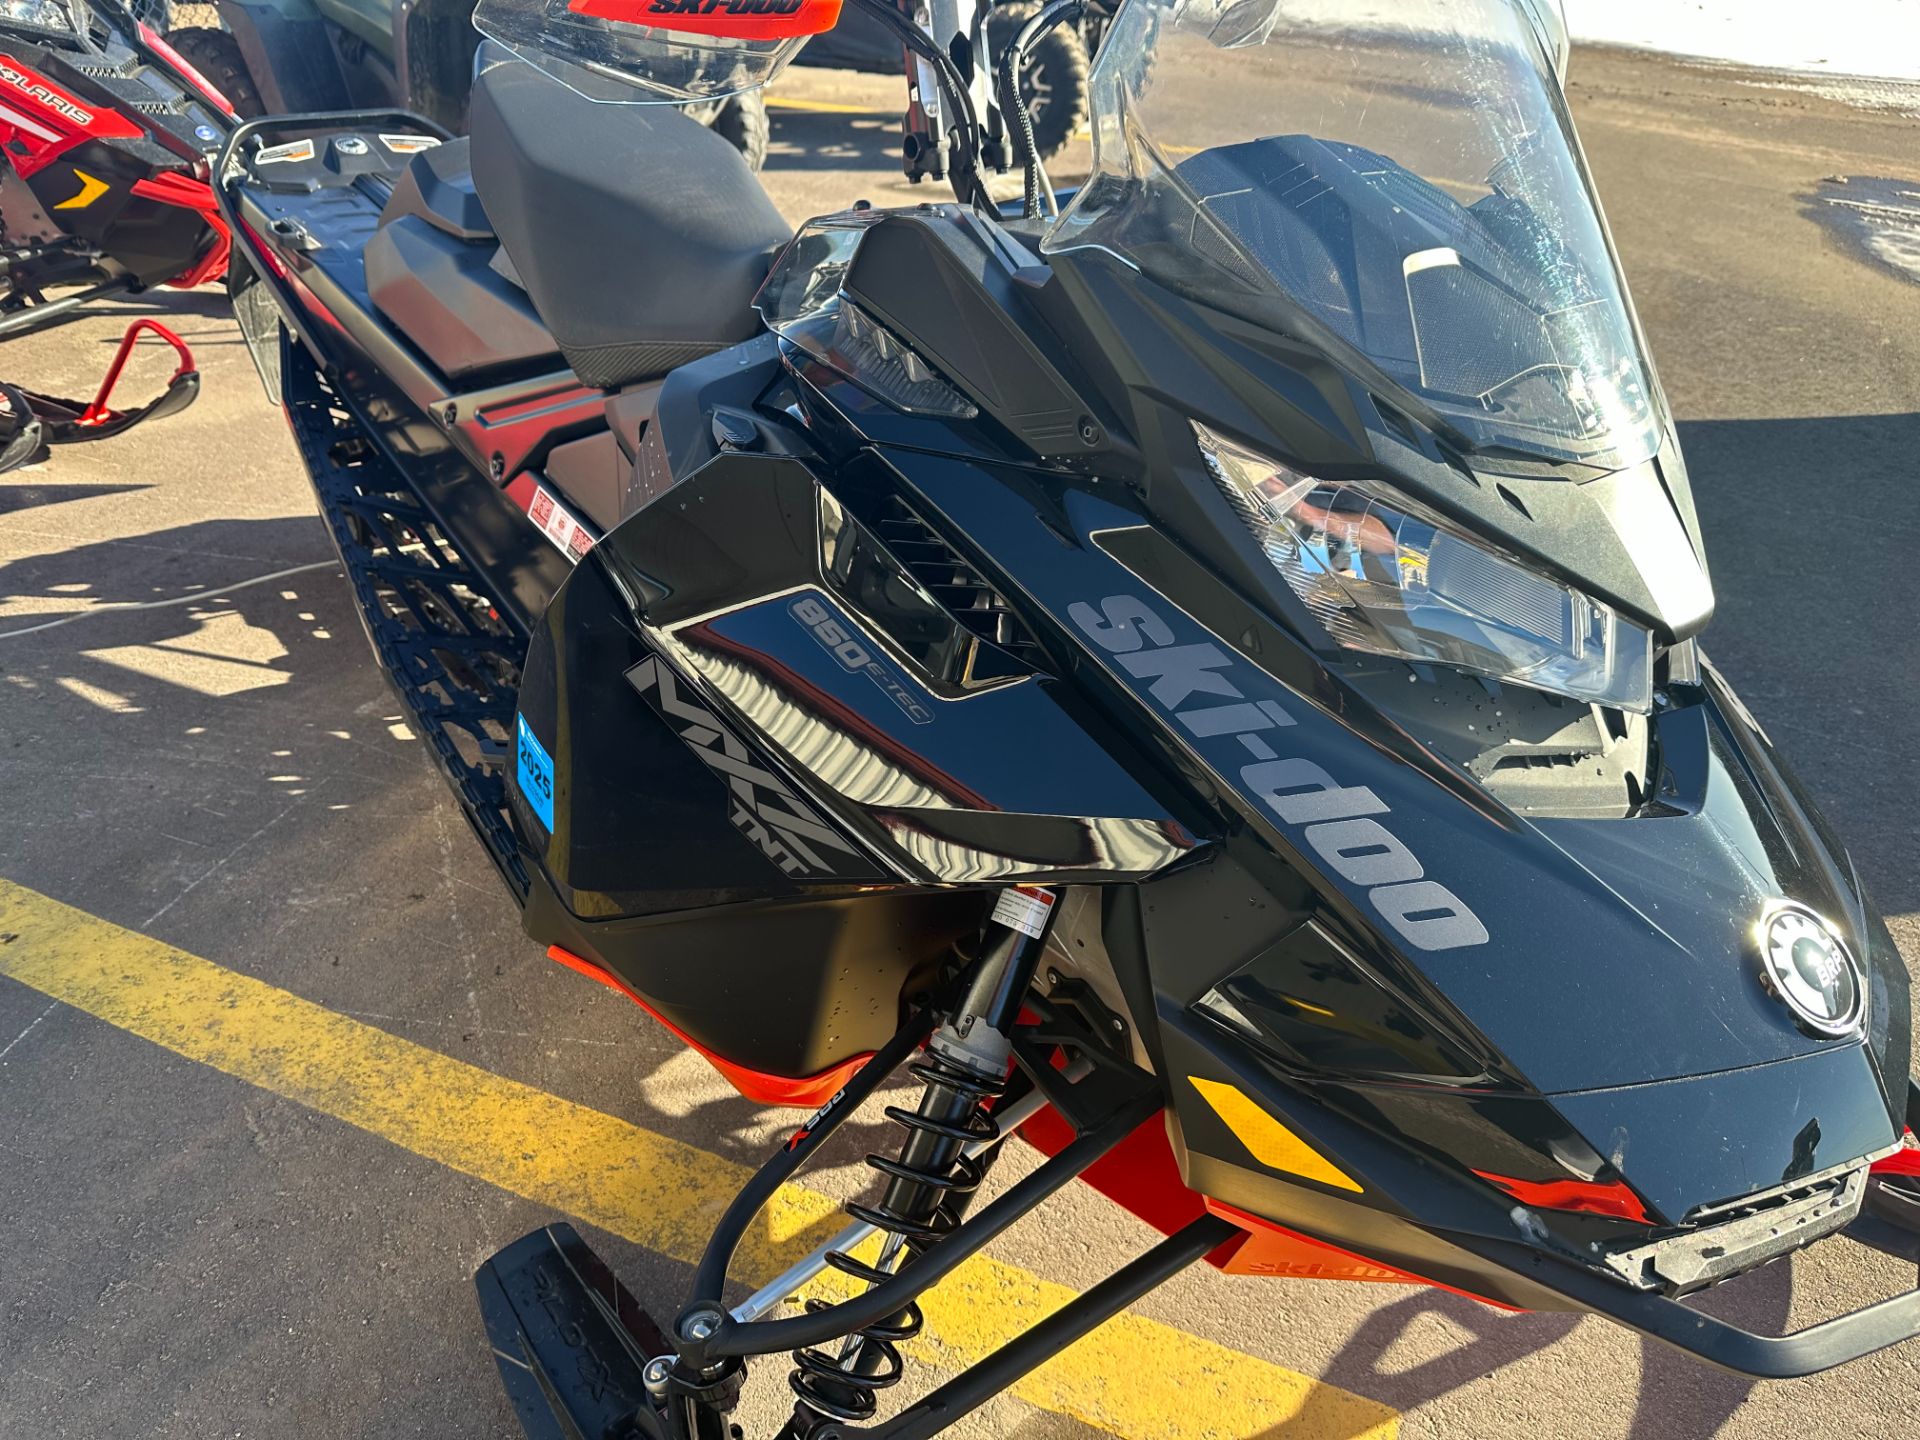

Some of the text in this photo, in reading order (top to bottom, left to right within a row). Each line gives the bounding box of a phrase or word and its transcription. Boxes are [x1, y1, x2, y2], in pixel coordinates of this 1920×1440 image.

[0, 64, 92, 125] OLARIS
[792, 598, 929, 718] 850 E-TEC
[520, 740, 550, 799] 2025
[731, 799, 810, 874] TNT
[1816, 950, 1842, 988] BRP
